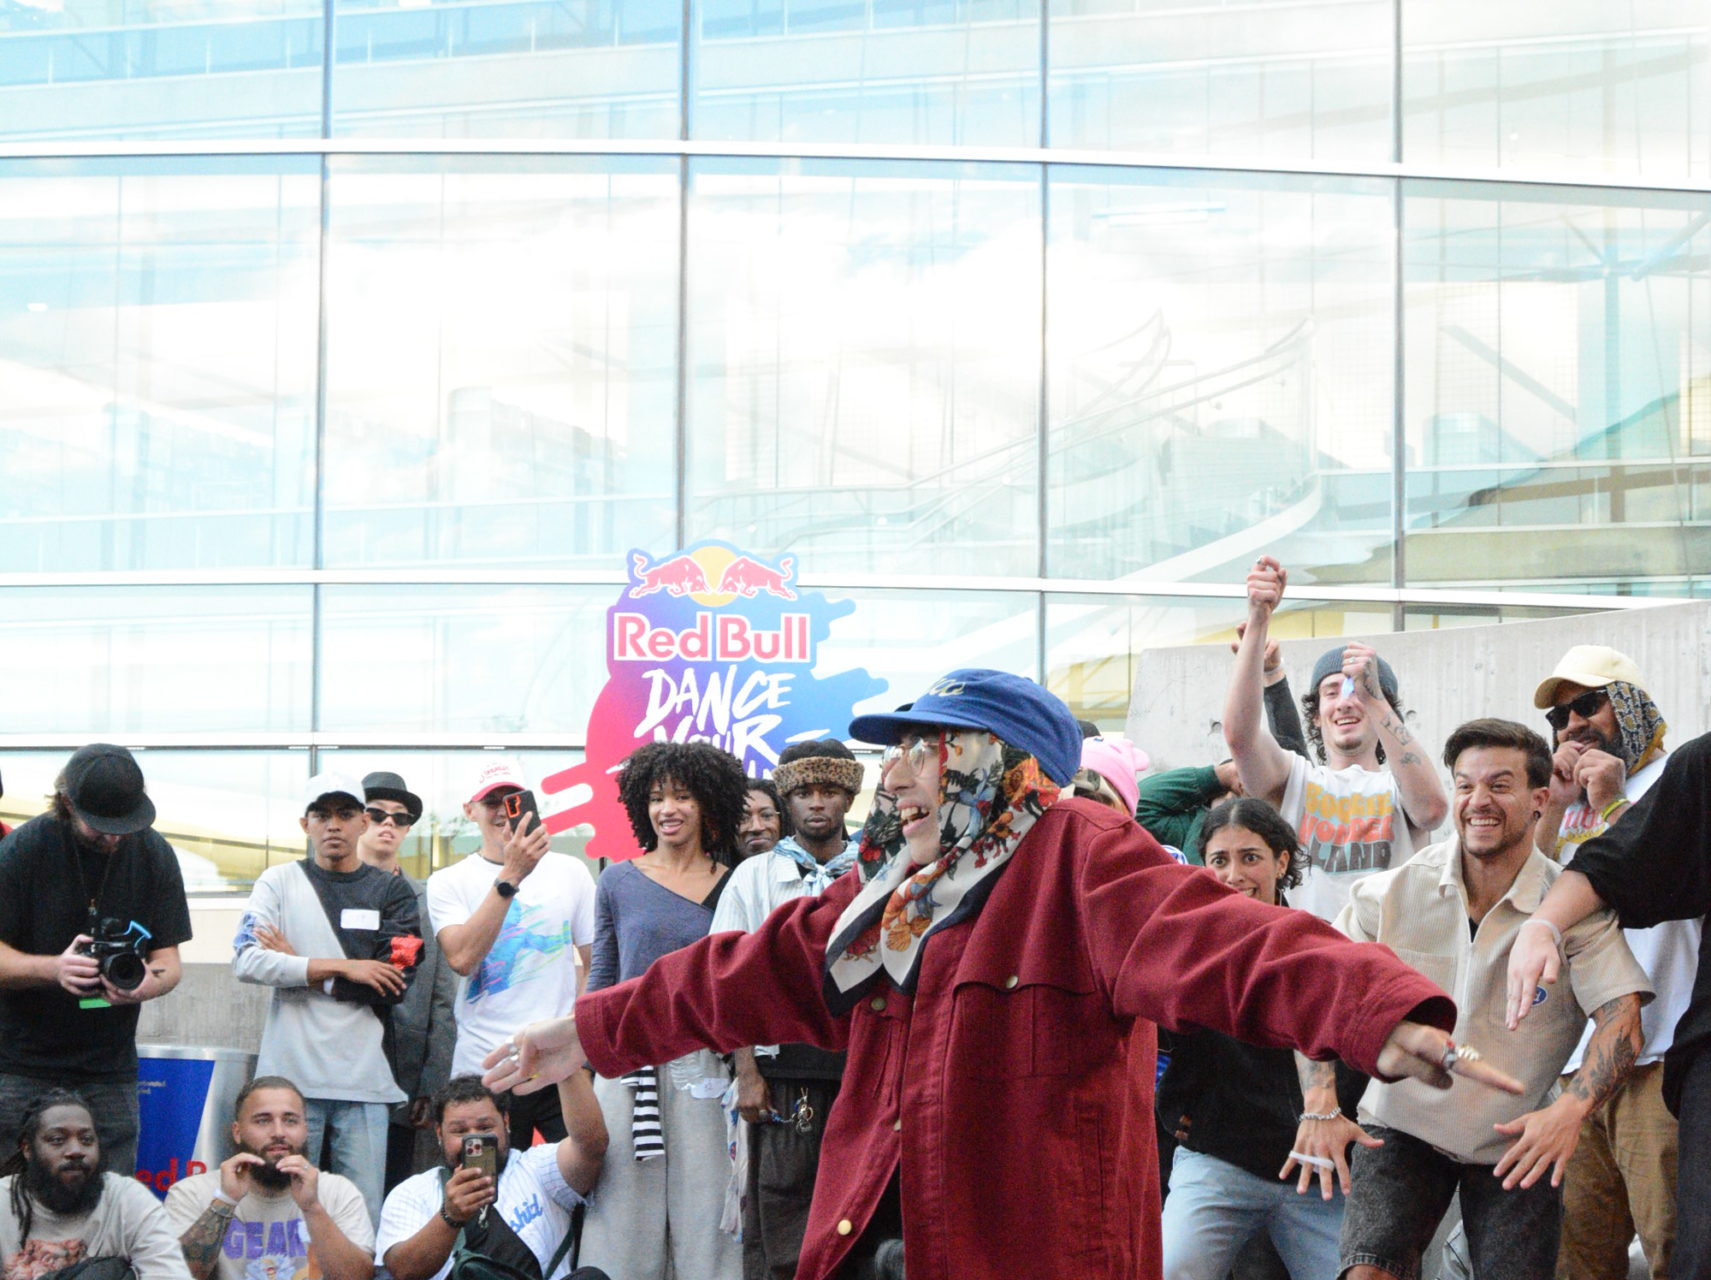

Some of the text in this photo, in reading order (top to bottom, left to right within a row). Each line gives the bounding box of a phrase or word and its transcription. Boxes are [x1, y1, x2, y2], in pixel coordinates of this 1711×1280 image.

[614, 612, 810, 663] Red Bull
[634, 664, 796, 740] DANCE
[1297, 812, 1395, 847] WONDER
[1308, 838, 1391, 873] LAND
[135, 1157, 179, 1192] ed
